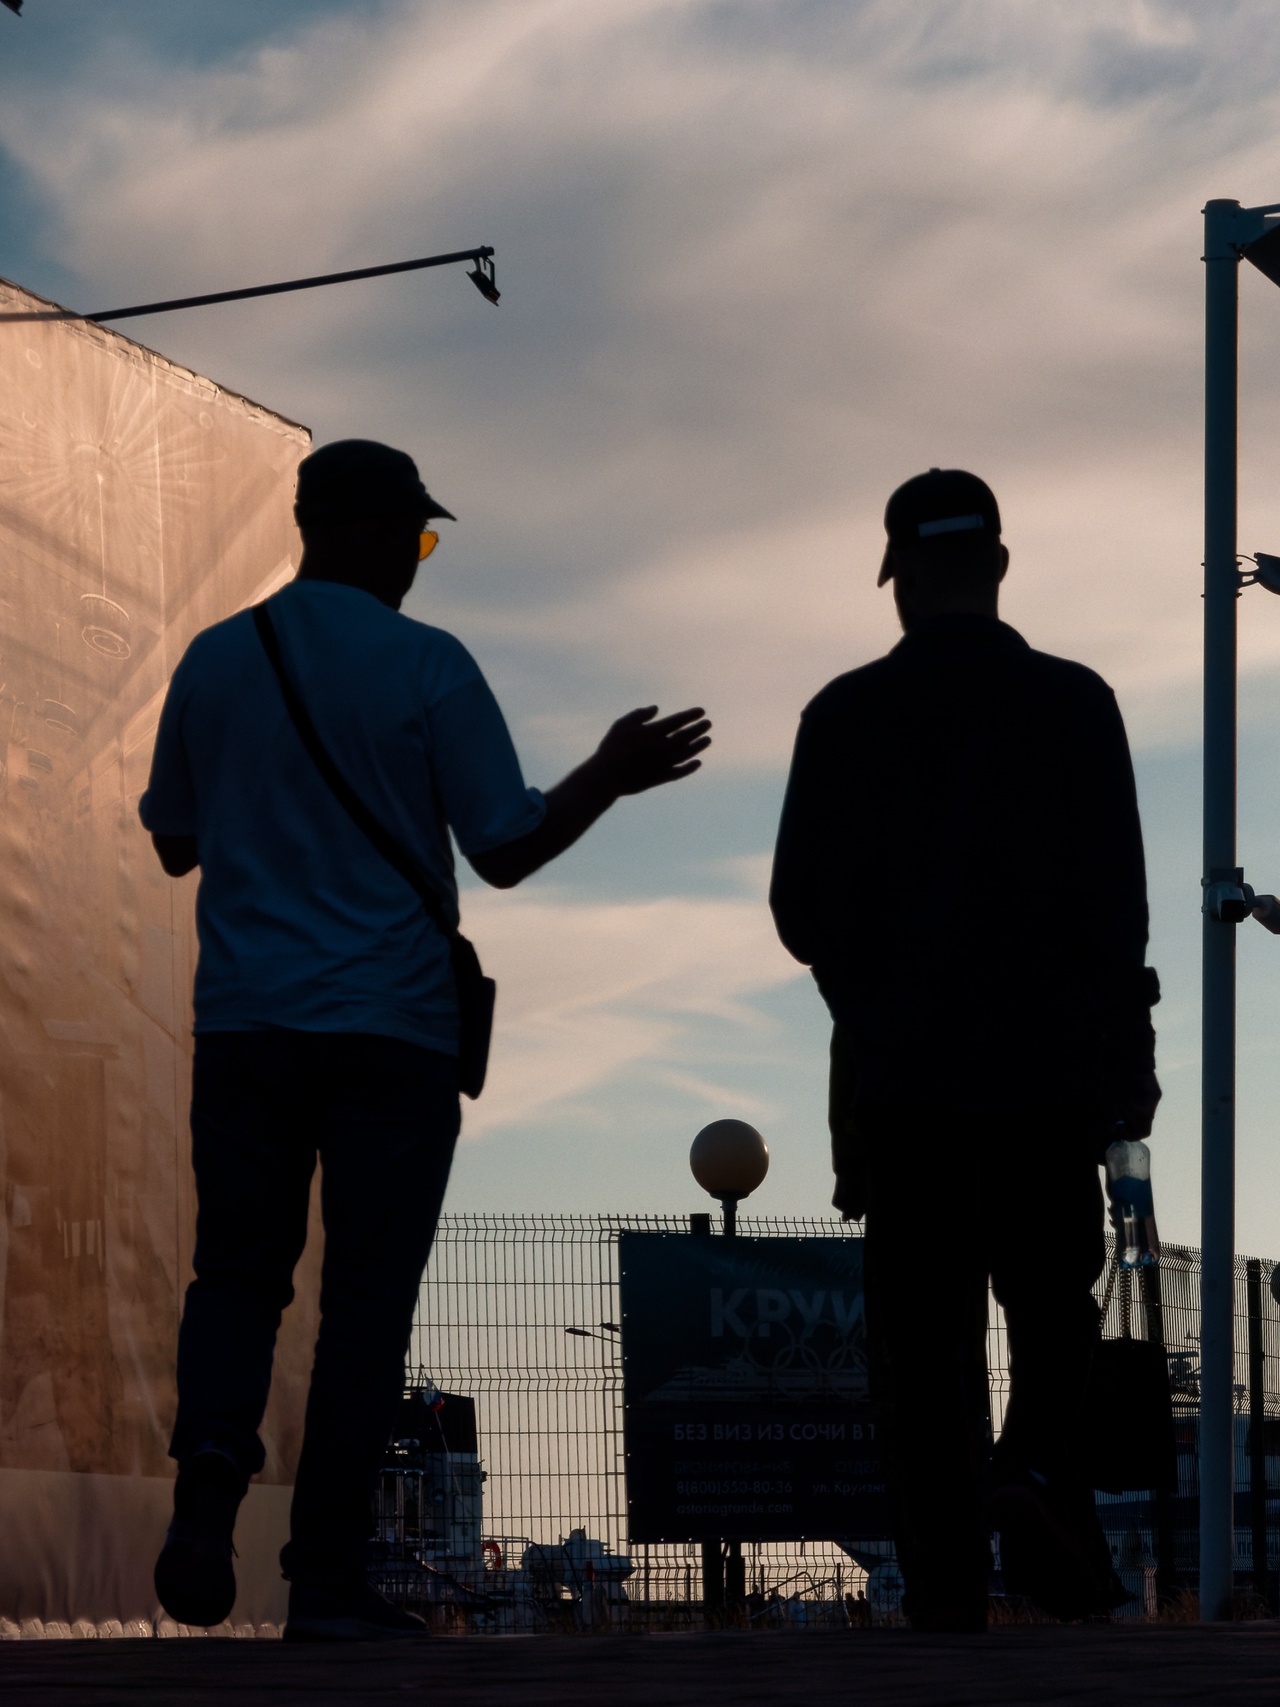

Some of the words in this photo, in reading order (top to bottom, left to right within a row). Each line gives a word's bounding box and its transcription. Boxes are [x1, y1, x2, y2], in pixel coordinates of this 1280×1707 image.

[673, 1423, 708, 1441] БЕЗ
[713, 1423, 752, 1441] ВИЗ
[757, 1423, 785, 1441] ИЗ
[789, 1423, 846, 1441] СОЧИ
[852, 1423, 864, 1441] В
[676, 1479, 793, 1496] 8(800)550-80-36
